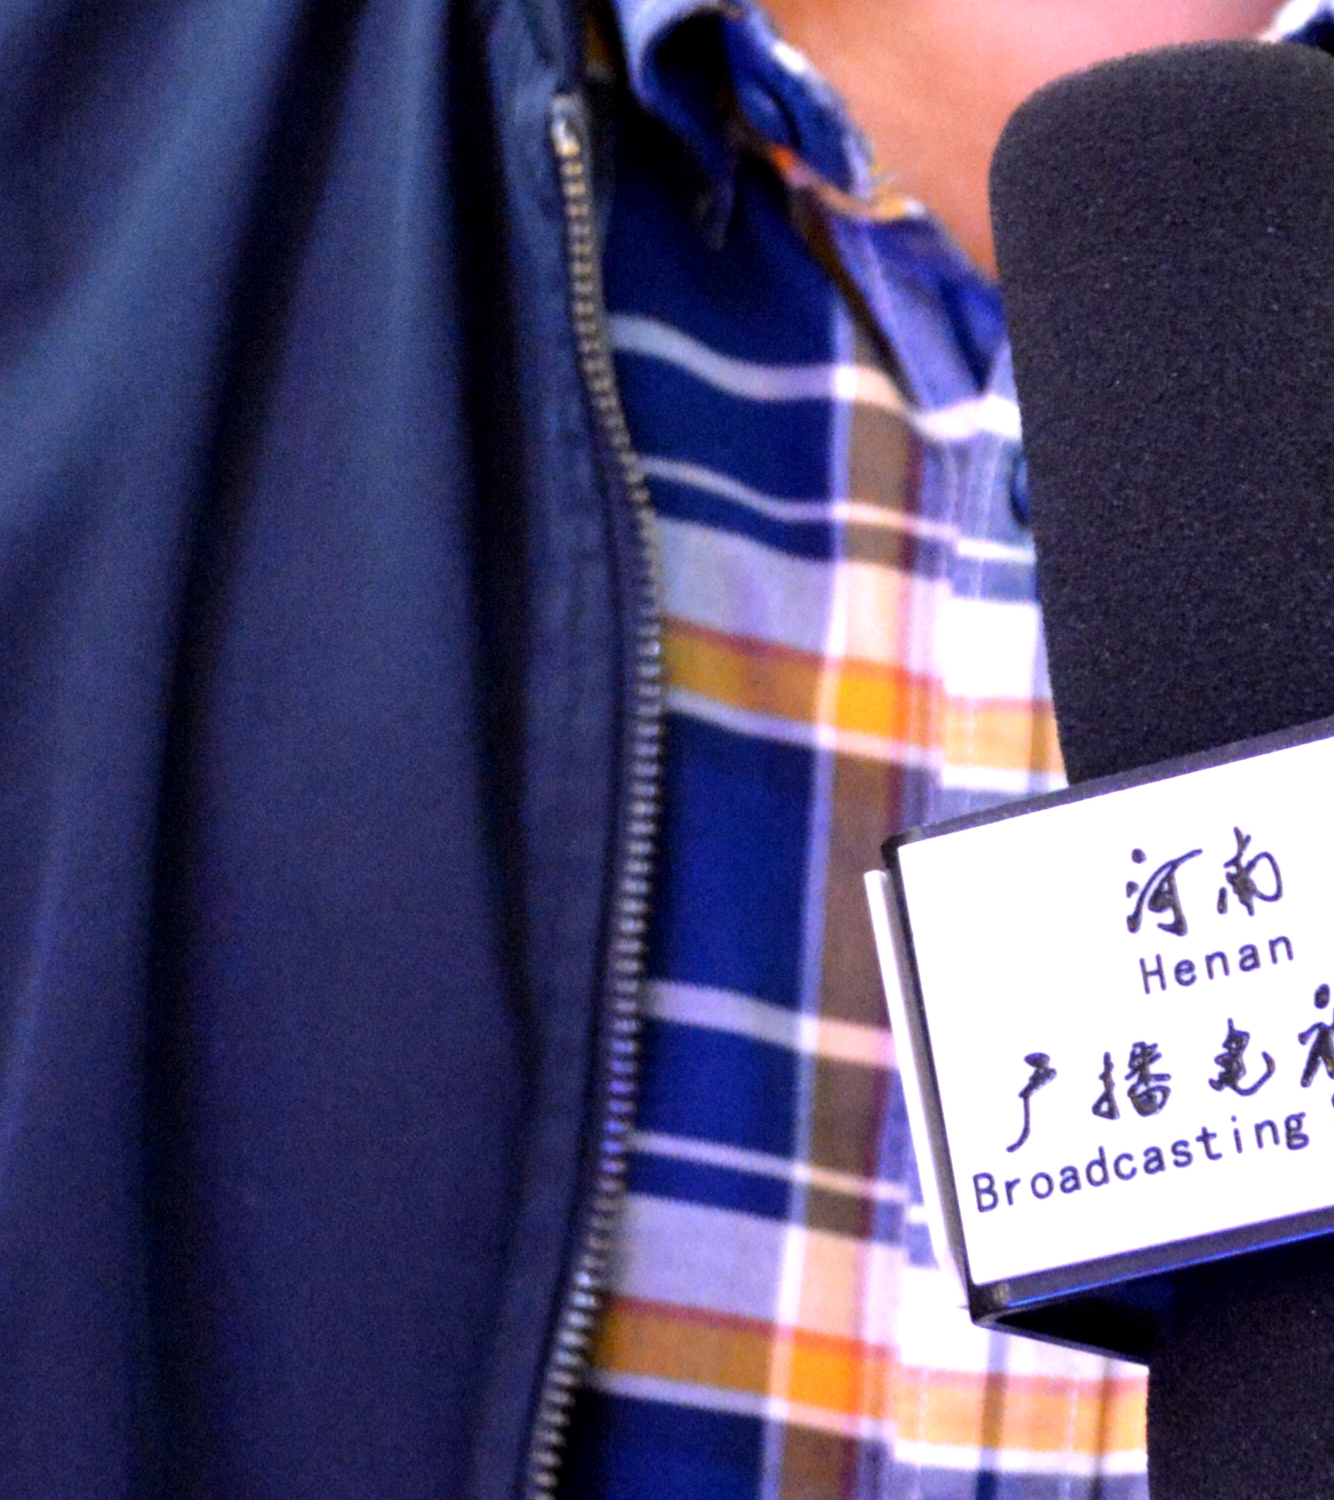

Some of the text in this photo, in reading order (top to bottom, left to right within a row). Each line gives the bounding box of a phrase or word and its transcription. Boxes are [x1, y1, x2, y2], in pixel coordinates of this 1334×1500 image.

[1125, 826, 1284, 935] 河南
[1139, 931, 1294, 995] Henan
[973, 1111, 1309, 1214] Broadcasting
